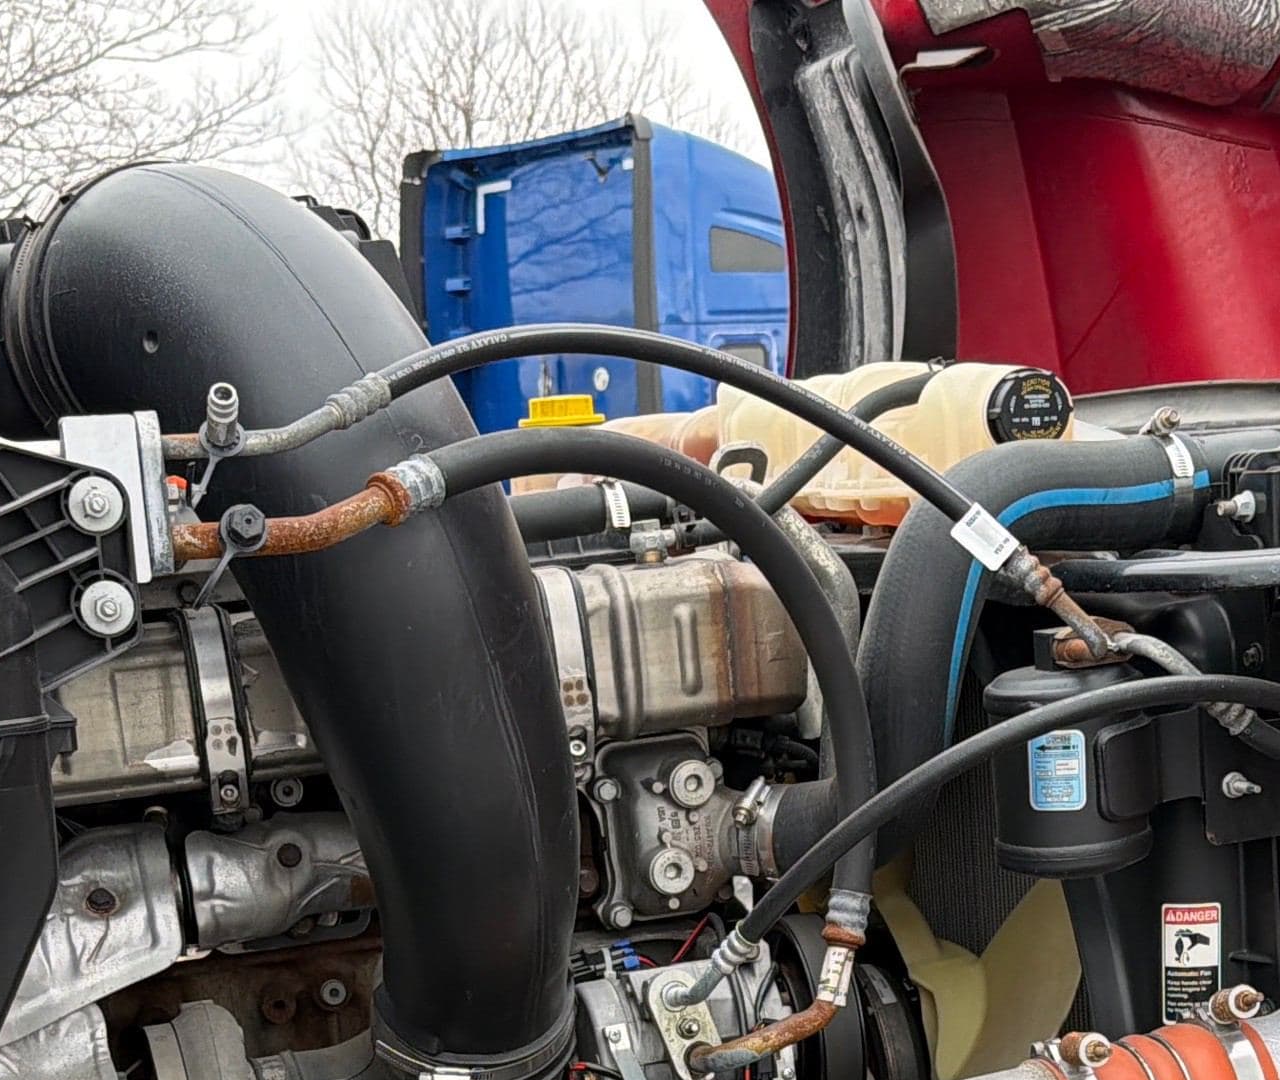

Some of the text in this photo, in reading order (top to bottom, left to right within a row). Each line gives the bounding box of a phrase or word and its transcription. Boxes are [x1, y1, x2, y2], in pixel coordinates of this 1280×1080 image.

[471, 334, 507, 349] GALAXY
[870, 430, 906, 455] GALAXY
[1175, 910, 1218, 922] DANGER
